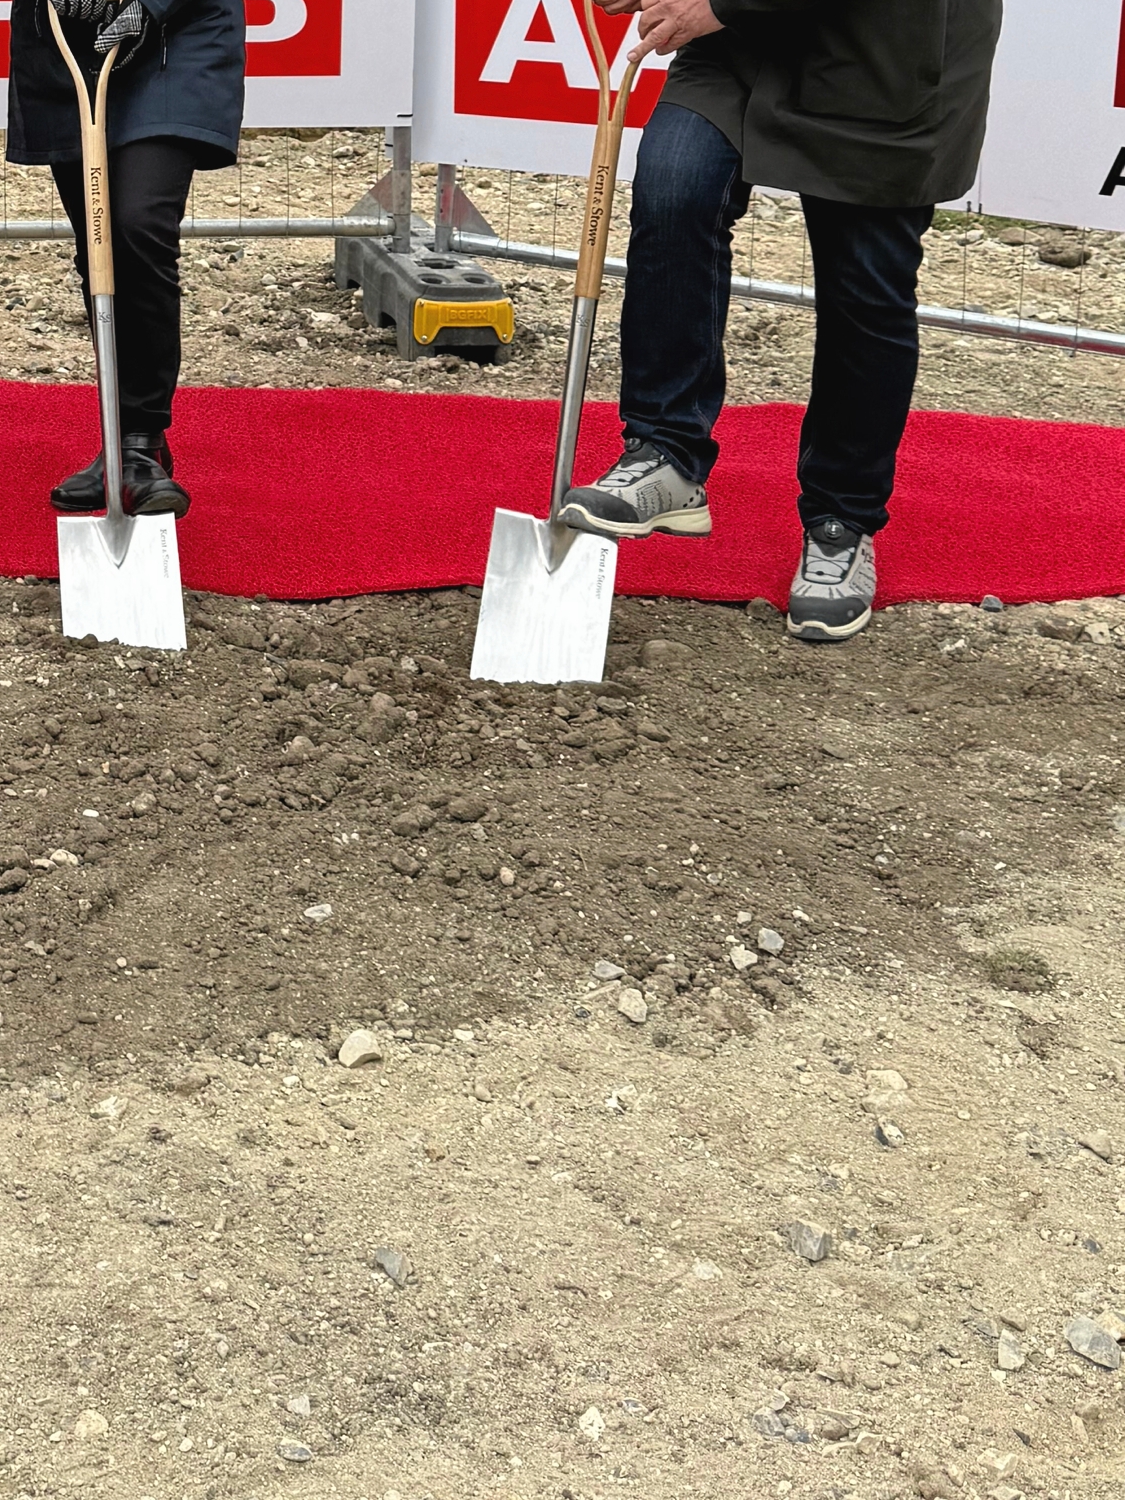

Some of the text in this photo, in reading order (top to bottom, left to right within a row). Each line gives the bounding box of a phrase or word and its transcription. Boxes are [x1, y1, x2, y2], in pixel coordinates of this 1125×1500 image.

[90, 167, 104, 245] Kent & Stowe
[587, 165, 609, 247] Kent & Stowe
